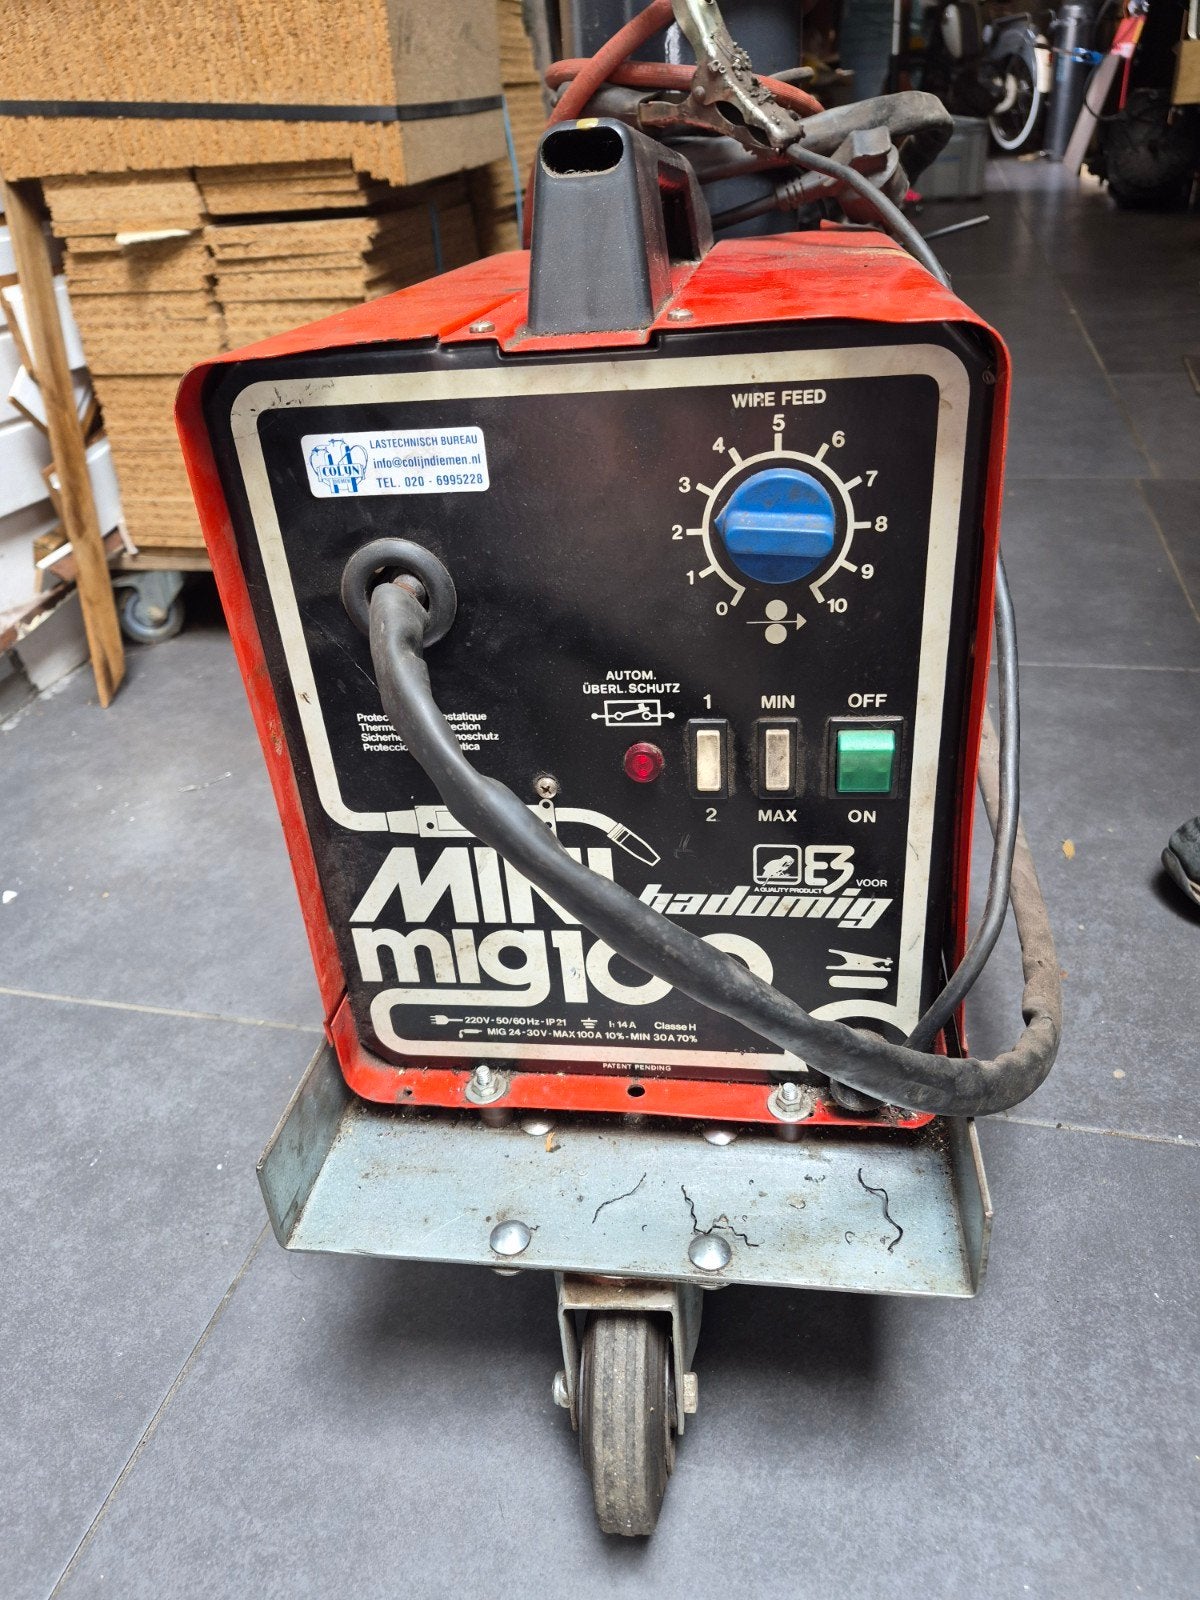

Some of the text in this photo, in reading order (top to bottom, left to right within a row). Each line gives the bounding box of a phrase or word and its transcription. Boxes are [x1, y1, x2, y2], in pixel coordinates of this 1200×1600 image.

[732, 389, 827, 408] WIRE FEED
[772, 414, 785, 431] 5
[369, 434, 478, 449] LASTECHNISCH BUREAU
[712, 437, 725, 453] 4
[832, 431, 846, 448] 6
[373, 454, 481, 469] info@colijndiemen.nl
[376, 477, 401, 488] TEL.
[404, 476, 425, 487] 020
[436, 473, 483, 485] 6995228
[678, 477, 691, 493] 3
[866, 470, 878, 487] 7
[875, 516, 888, 532] 8
[671, 525, 683, 540] 2
[686, 570, 695, 585] 1
[861, 564, 875, 579] 9
[716, 602, 728, 616] 0
[827, 598, 848, 613] 10
[606, 670, 657, 681] AUTOM.
[703, 694, 712, 709] 1
[761, 695, 795, 709] MIN
[847, 693, 888, 708] OFF
[356, 713, 390, 722] Protec
[705, 808, 717, 822] 2
[758, 810, 798, 822] MAX
[847, 810, 876, 823] ON
[856, 879, 888, 888] VOOR
[487, 1027, 507, 1036] MIG
[654, 1021, 687, 1031] Classe
[689, 1023, 697, 1031] H
[602, 1062, 672, 1071] PATENT PENDING
